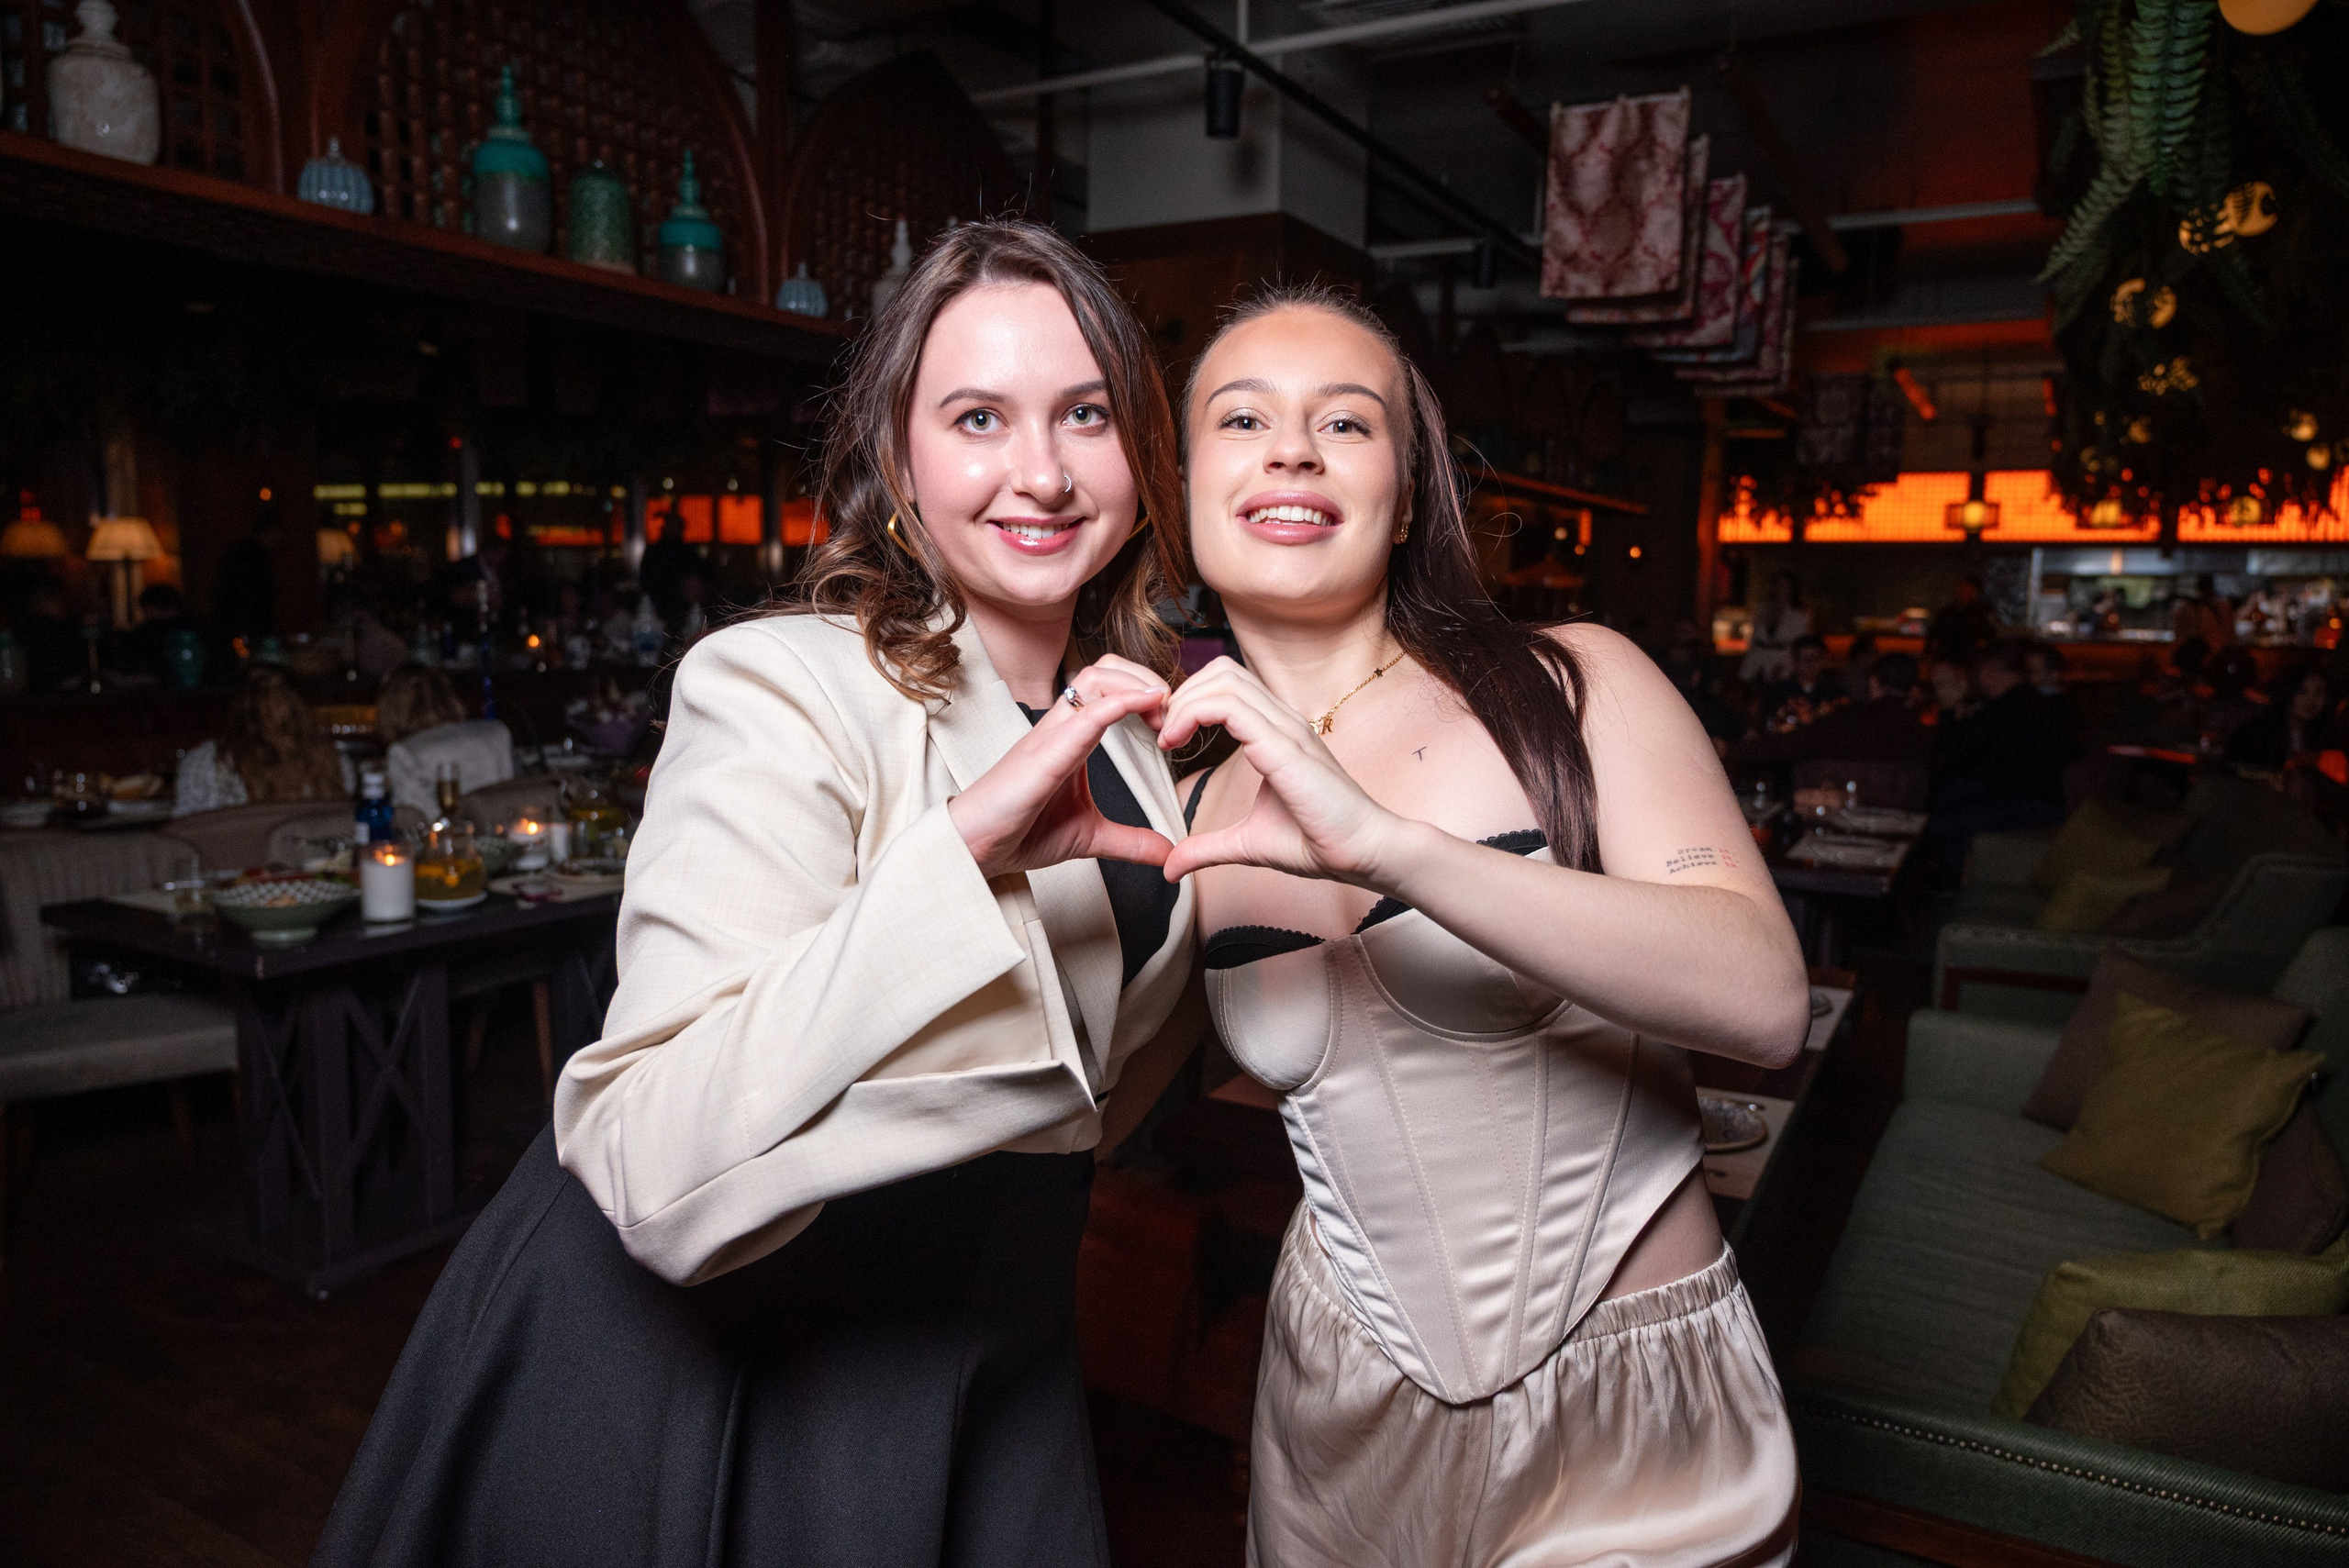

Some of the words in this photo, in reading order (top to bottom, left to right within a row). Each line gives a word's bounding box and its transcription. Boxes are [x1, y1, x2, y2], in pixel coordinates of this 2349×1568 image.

[1411, 746, 1427, 761] T
[1677, 847, 1713, 855] Dream
[1665, 854, 1714, 867] Believe
[1669, 861, 1718, 874] Achieve
